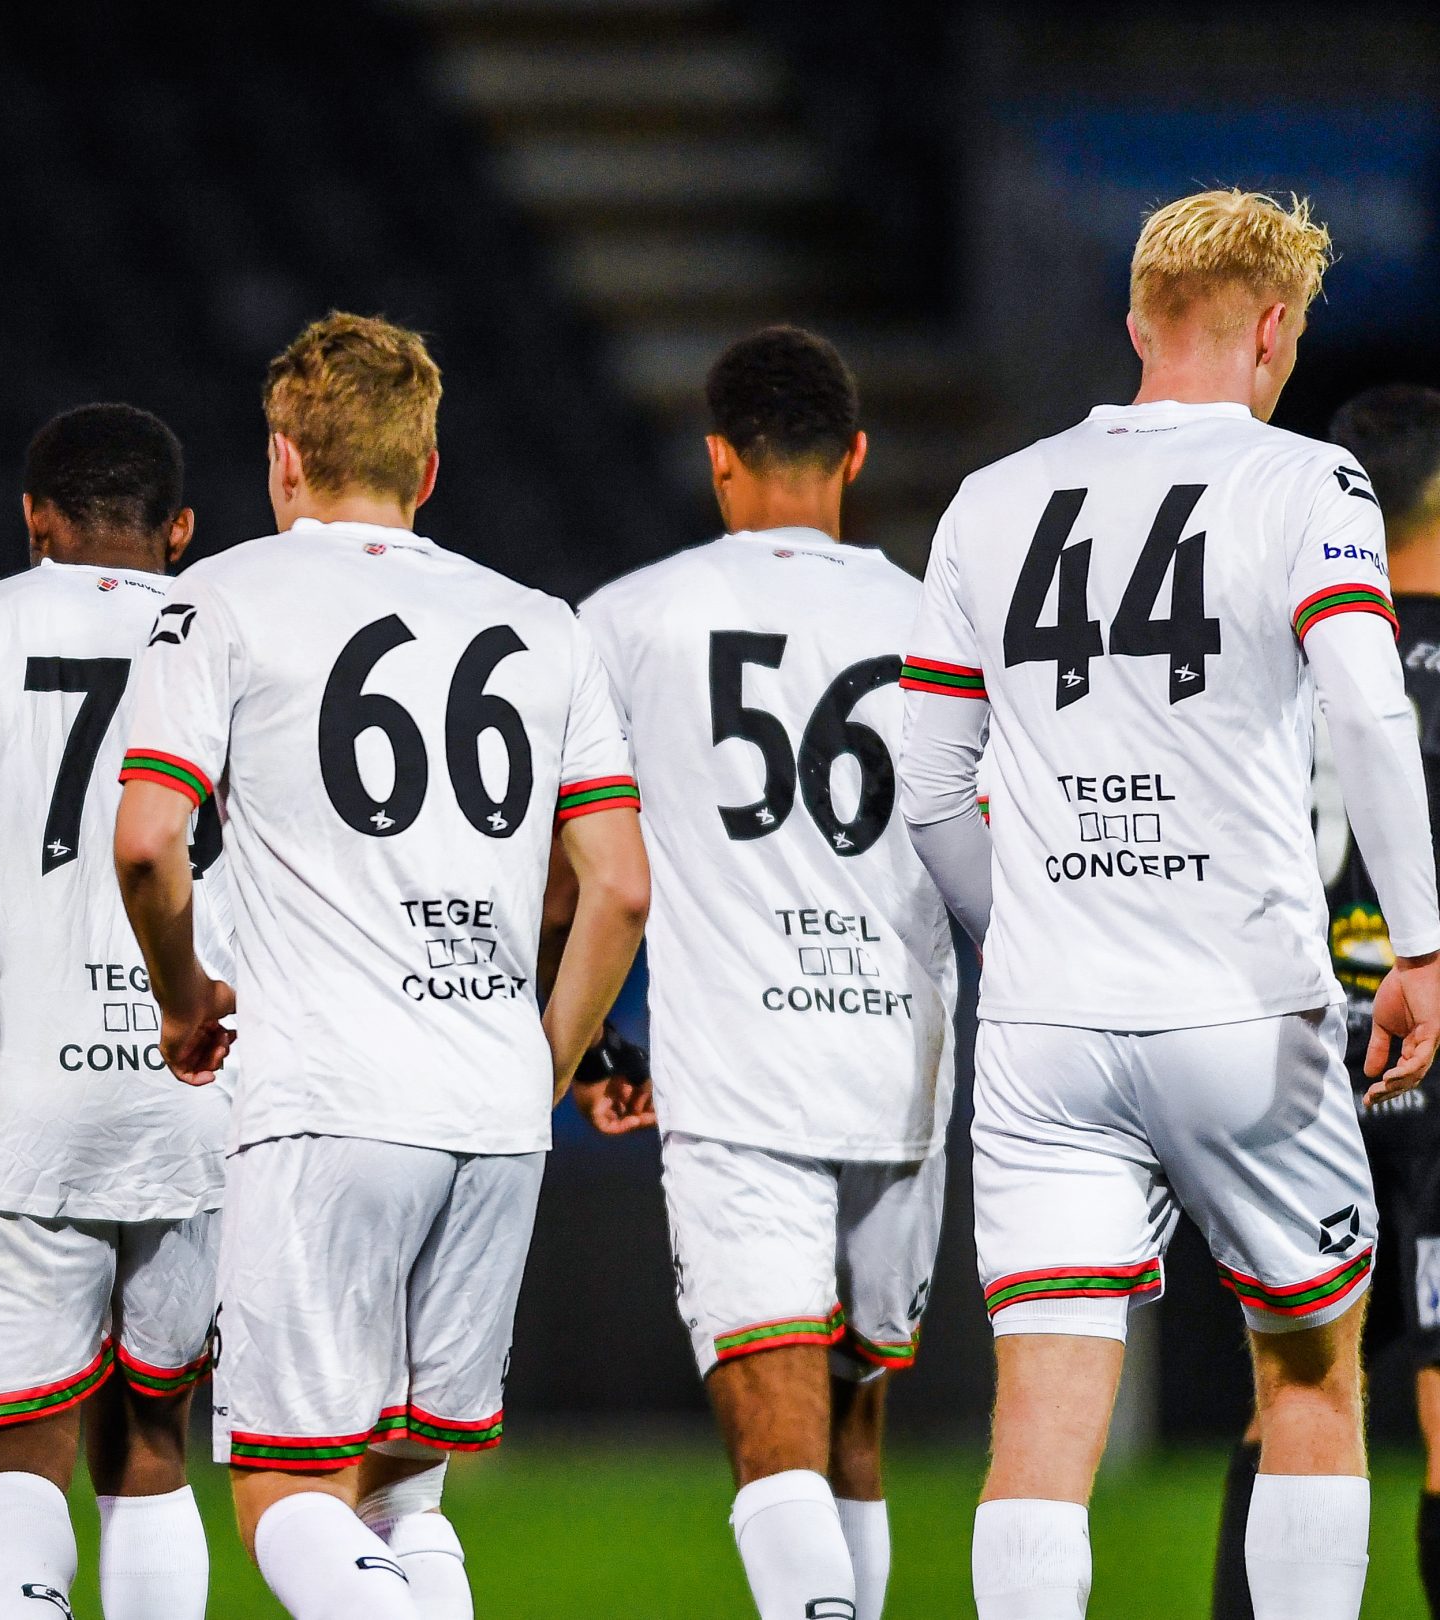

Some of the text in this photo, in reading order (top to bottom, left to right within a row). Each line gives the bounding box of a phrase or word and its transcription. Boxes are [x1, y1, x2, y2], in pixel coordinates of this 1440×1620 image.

[1003, 483, 1222, 712] 44
[318, 613, 532, 838] 66
[708, 629, 904, 857] 56
[1057, 774, 1176, 803] TEGEL
[1045, 849, 1210, 883] CONCEPT
[400, 898, 498, 930] TEGE
[85, 963, 151, 993] TEG
[762, 986, 913, 1020] CONCEPT
[59, 1043, 224, 1072] CONC
